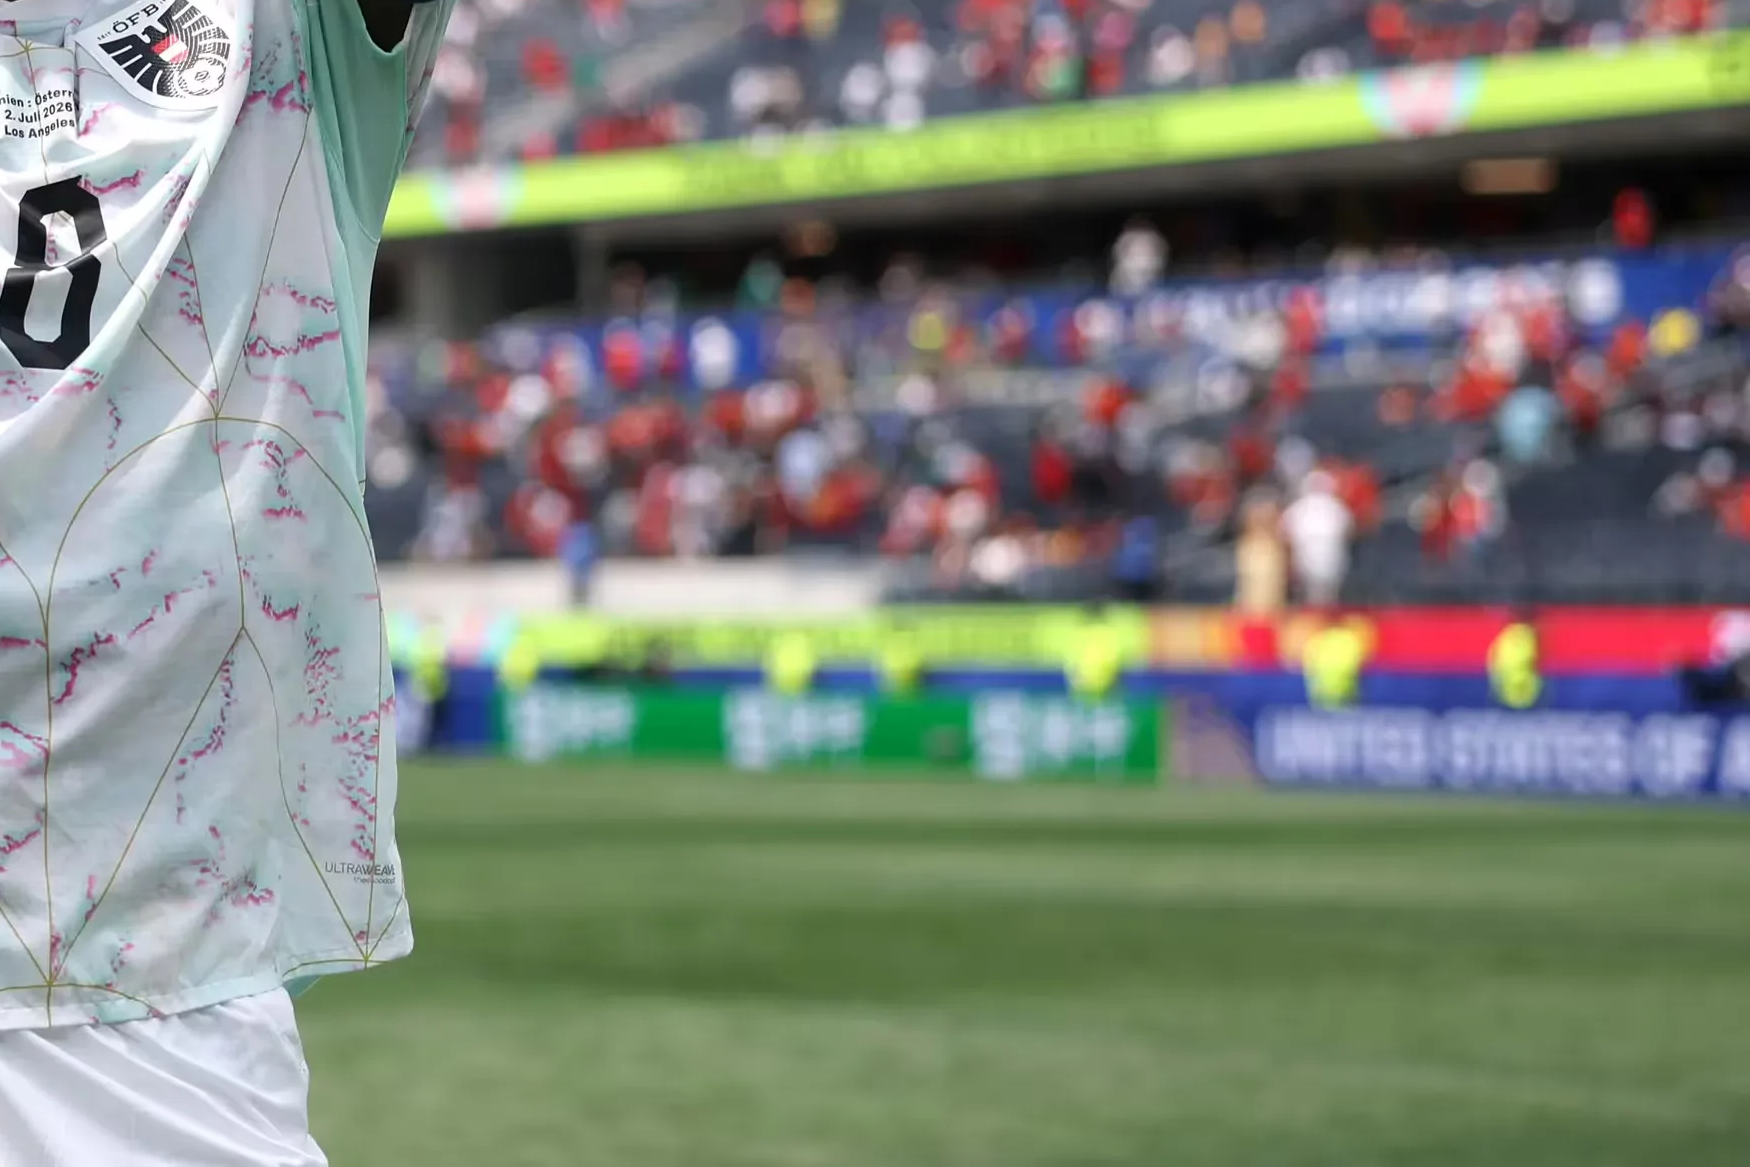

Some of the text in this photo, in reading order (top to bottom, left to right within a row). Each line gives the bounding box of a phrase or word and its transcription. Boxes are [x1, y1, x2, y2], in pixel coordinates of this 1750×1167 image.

[112, 3, 159, 33] ÖFB
[35, 89, 74, 106] Österr
[43, 102, 73, 119] 2026
[4, 119, 75, 139] Los Angeles
